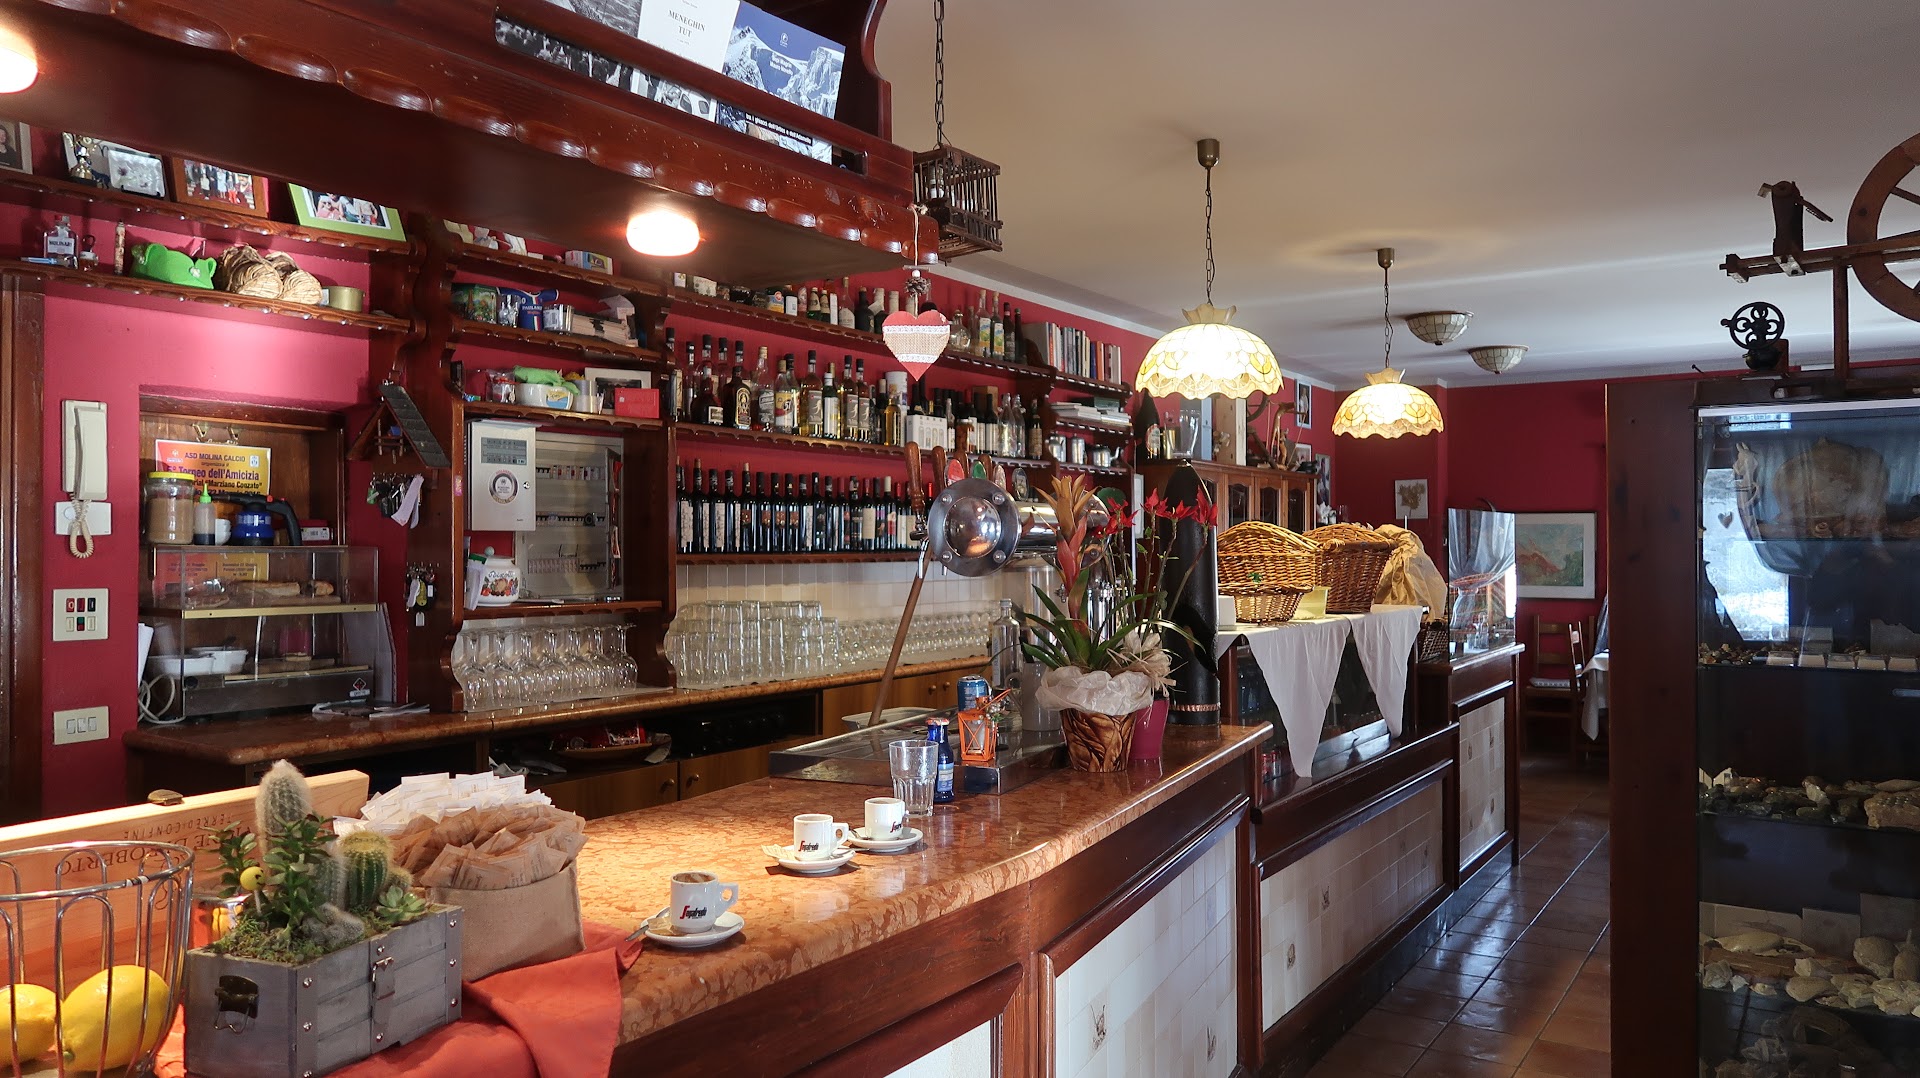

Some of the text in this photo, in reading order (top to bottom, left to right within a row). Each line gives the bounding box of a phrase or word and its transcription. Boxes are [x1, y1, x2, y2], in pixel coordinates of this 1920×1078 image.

[668, 10, 705, 31] MENEGHIN
[678, 26, 692, 37] TUT
[199, 453, 222, 461] MOLINA
[223, 454, 246, 462] CALCIO
[178, 466, 206, 478] Torneo
[208, 467, 259, 481] dell'Amicizia
